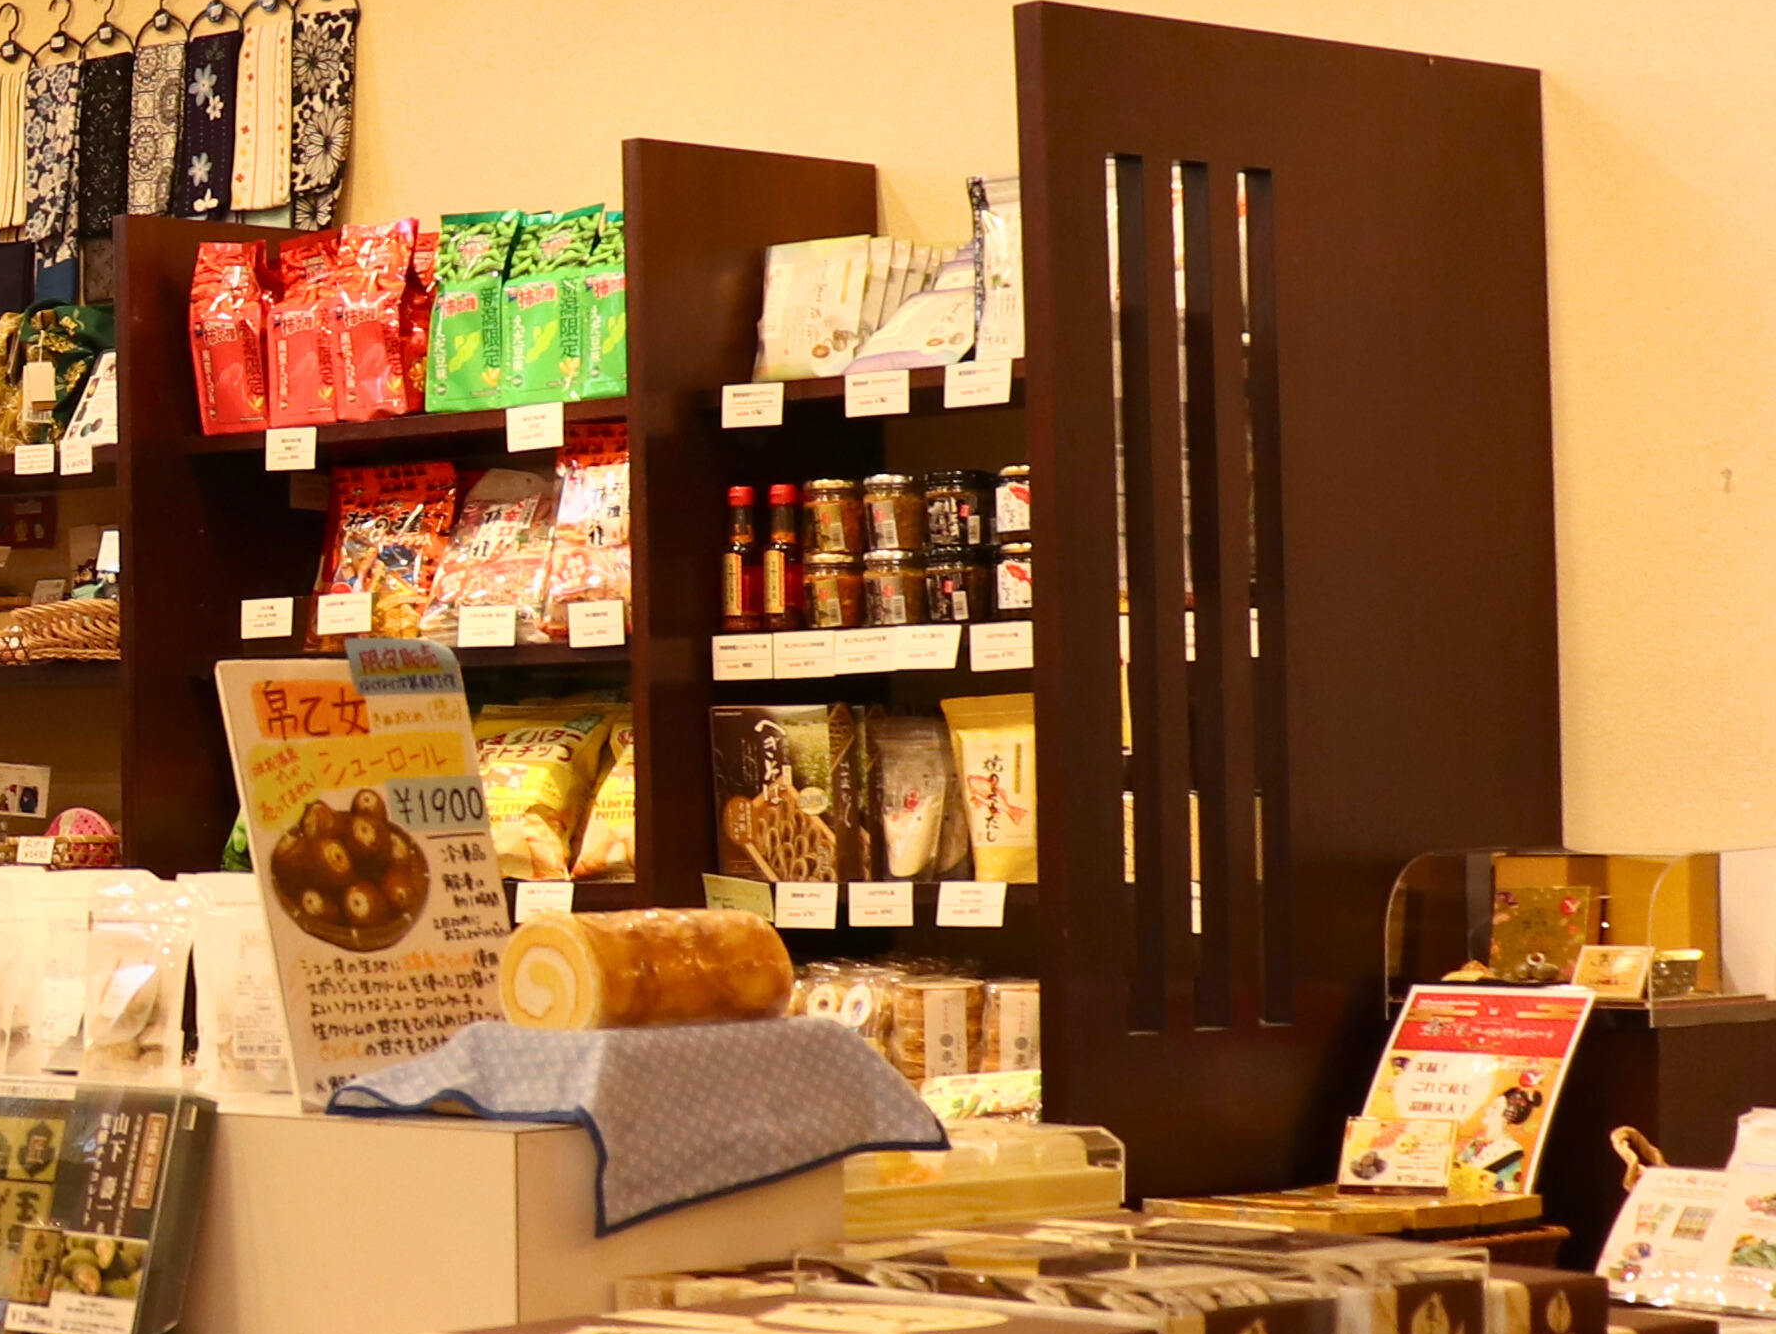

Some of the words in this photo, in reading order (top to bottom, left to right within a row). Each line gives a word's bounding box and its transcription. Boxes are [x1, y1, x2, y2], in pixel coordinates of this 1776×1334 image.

[317, 743, 447, 787] シューロール
[393, 784, 485, 825] ¥1900
